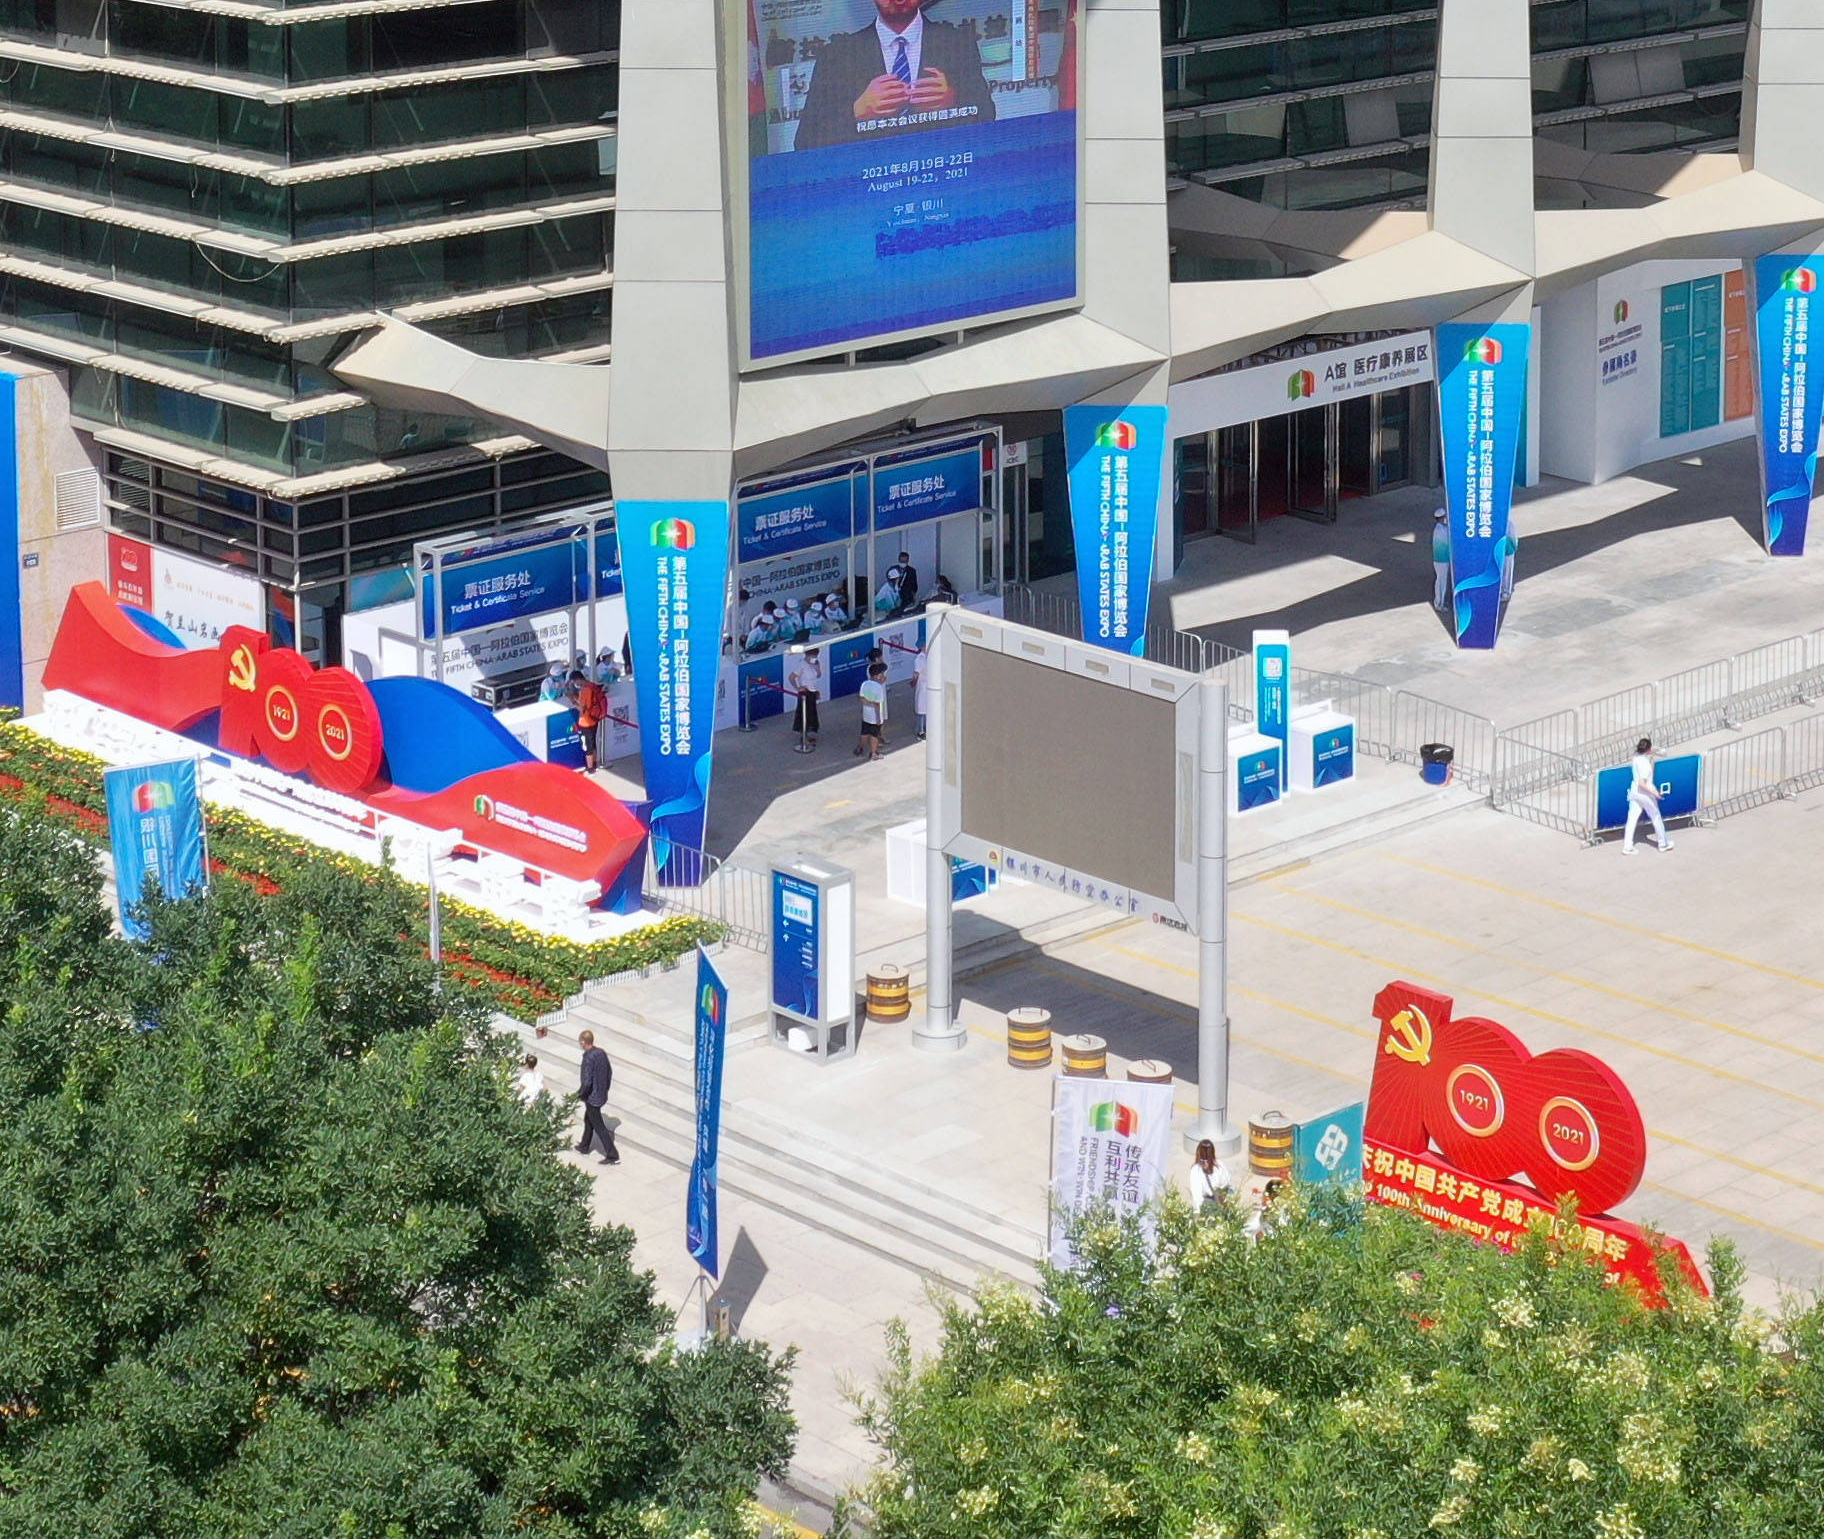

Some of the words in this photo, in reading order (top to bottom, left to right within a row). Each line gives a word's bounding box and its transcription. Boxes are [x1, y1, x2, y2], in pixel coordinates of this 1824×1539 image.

[862, 152, 973, 179] 2021年8月19日-22日
[868, 179, 903, 192] August
[945, 167, 968, 179] 2021
[1784, 297, 1794, 312] THE
[1784, 313, 1794, 336] FIFTH
[1325, 362, 1347, 382] A馆
[1354, 344, 1428, 375] 医疗康养展区
[1468, 370, 1478, 386] THE
[1468, 387, 1478, 412] FIFTH
[1780, 396, 1790, 428] STATES
[1779, 428, 1789, 453] EXPO
[1100, 456, 1111, 473] THE
[889, 474, 945, 500] 票证服务处
[1100, 475, 1111, 501] FIFTH
[1466, 476, 1477, 511] STATES
[755, 504, 815, 532] 票证服务处
[1465, 511, 1476, 538] EXPO
[743, 535, 761, 545] Ticket
[656, 556, 668, 575] THE
[464, 569, 531, 600] 票证服务处
[657, 577, 669, 606] FIFTH
[794, 575, 818, 588] STATES
[819, 572, 840, 582] EXPO
[1099, 571, 1110, 608] STATES
[451, 601, 472, 615] Ticket
[474, 601, 480, 609] &
[482, 592, 517, 608] Certificate
[520, 586, 545, 598] Service
[1099, 609, 1110, 638] EXPO
[446, 664, 465, 674] FIFTH
[519, 645, 546, 658] STATES
[547, 637, 569, 650] EXPO
[272, 705, 291, 721] 1921
[659, 683, 671, 723] STATES
[325, 724, 345, 741] 2021
[660, 724, 671, 755] EXPO
[1007, 857, 1140, 912] 银川市人民防空办公室
[1460, 1090, 1489, 1111] 1921
[1552, 1123, 1584, 1144] 2021
[1122, 1144, 1142, 1204] 传承友谊
[1376, 1183, 1410, 1207] 100th
[1495, 1229, 1511, 1246] of
